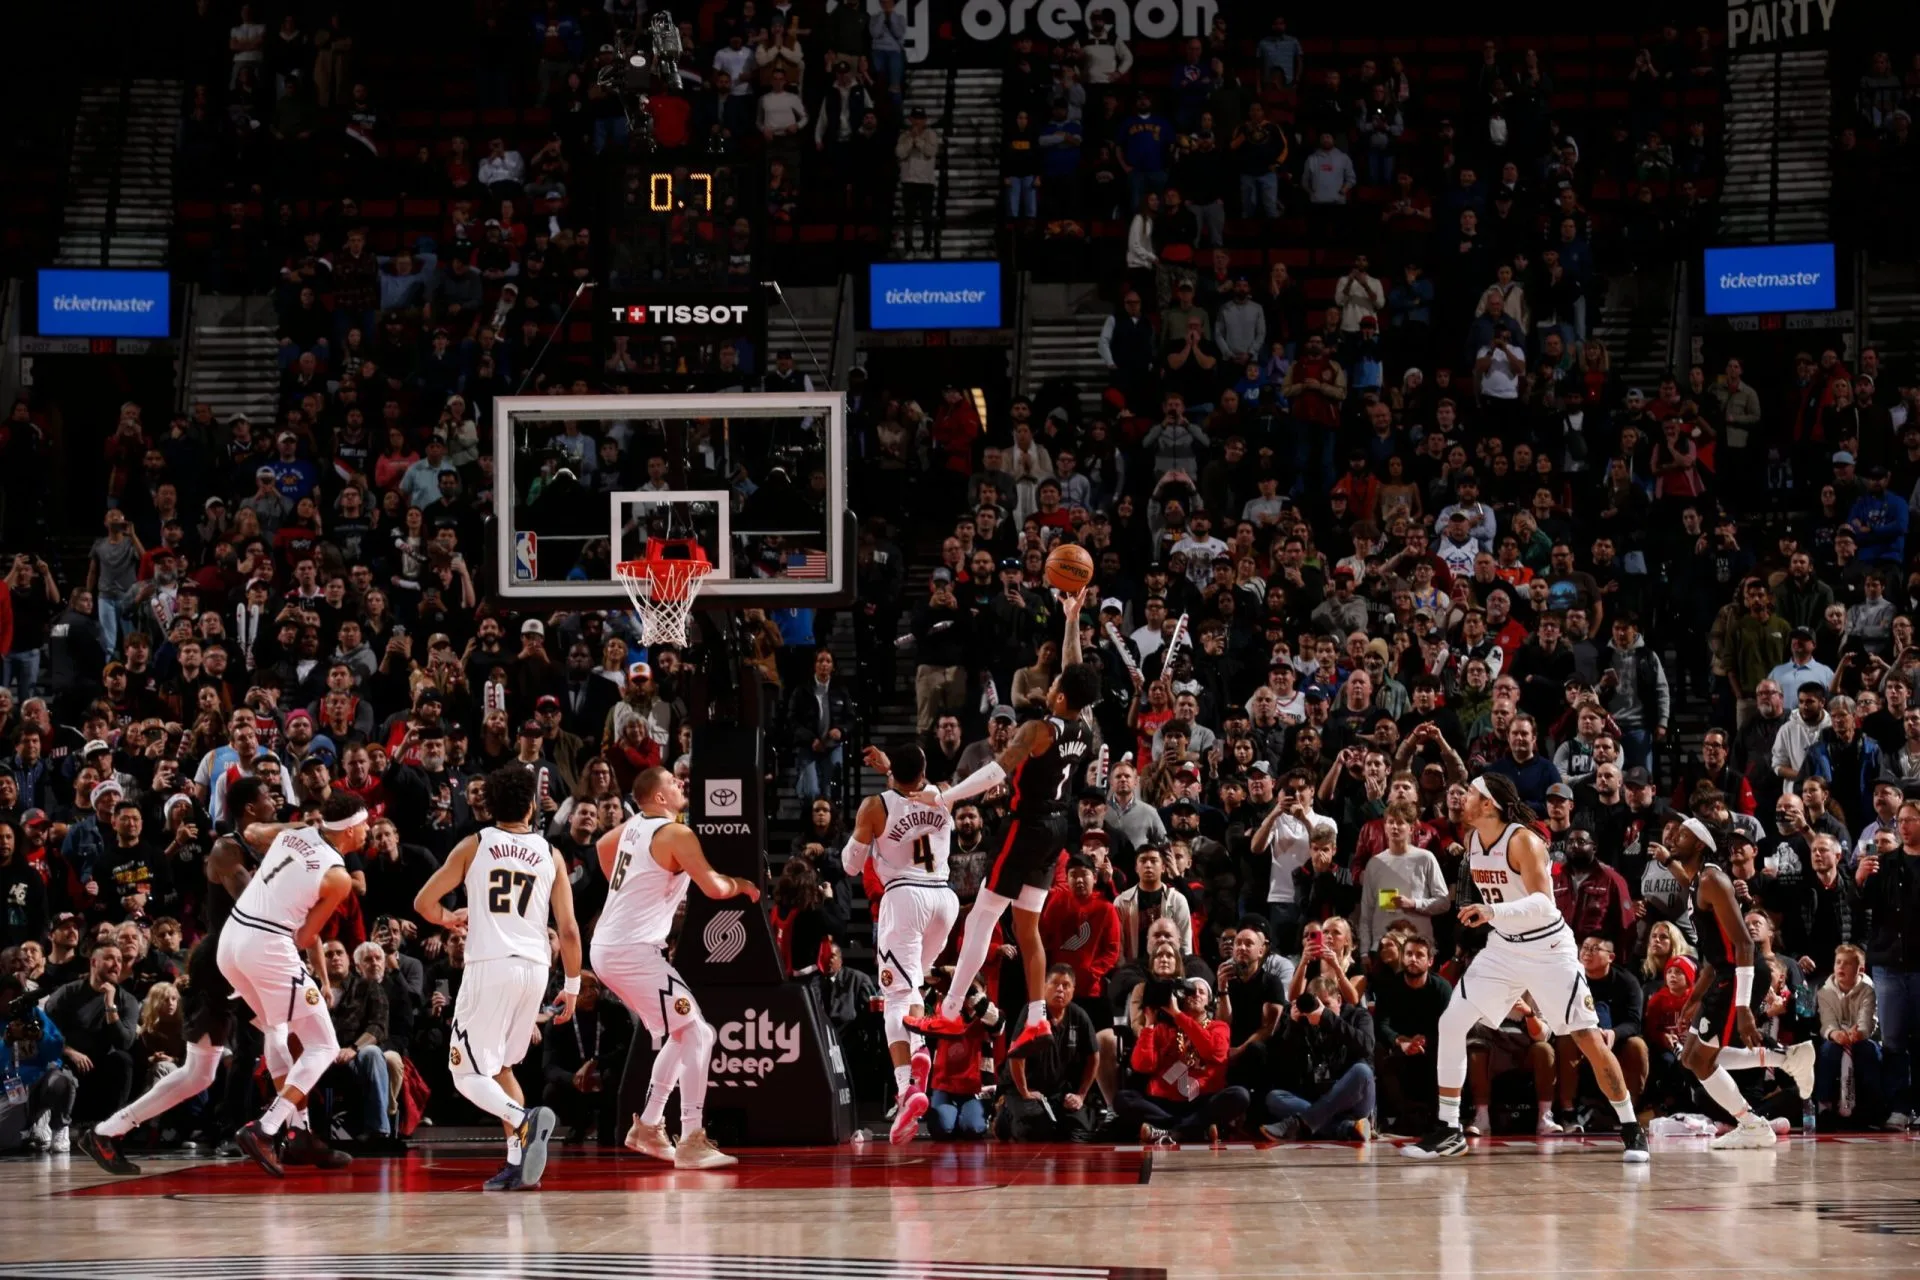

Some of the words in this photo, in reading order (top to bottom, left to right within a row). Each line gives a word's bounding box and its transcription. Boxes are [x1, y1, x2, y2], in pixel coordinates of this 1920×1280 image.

[1727, 0, 1836, 48] PARTY
[650, 172, 712, 212] 0.7
[1719, 271, 1821, 289] ticketmaster
[52, 294, 155, 312] ticketmaster
[885, 287, 987, 305] ticketmaster
[649, 305, 749, 324] TISSOT
[696, 823, 752, 835] TOYOTA
[281, 835, 316, 858] PORTER
[488, 843, 544, 868] MURRAY
[913, 834, 935, 873] 4
[610, 850, 633, 892] 15
[1471, 869, 1509, 885] NUGGETS
[488, 868, 538, 919] 27
[1643, 878, 1682, 893] BLAZERS
[1667, 893, 1676, 908] 0
[718, 1008, 801, 1064] city
[710, 1052, 775, 1080] deep
